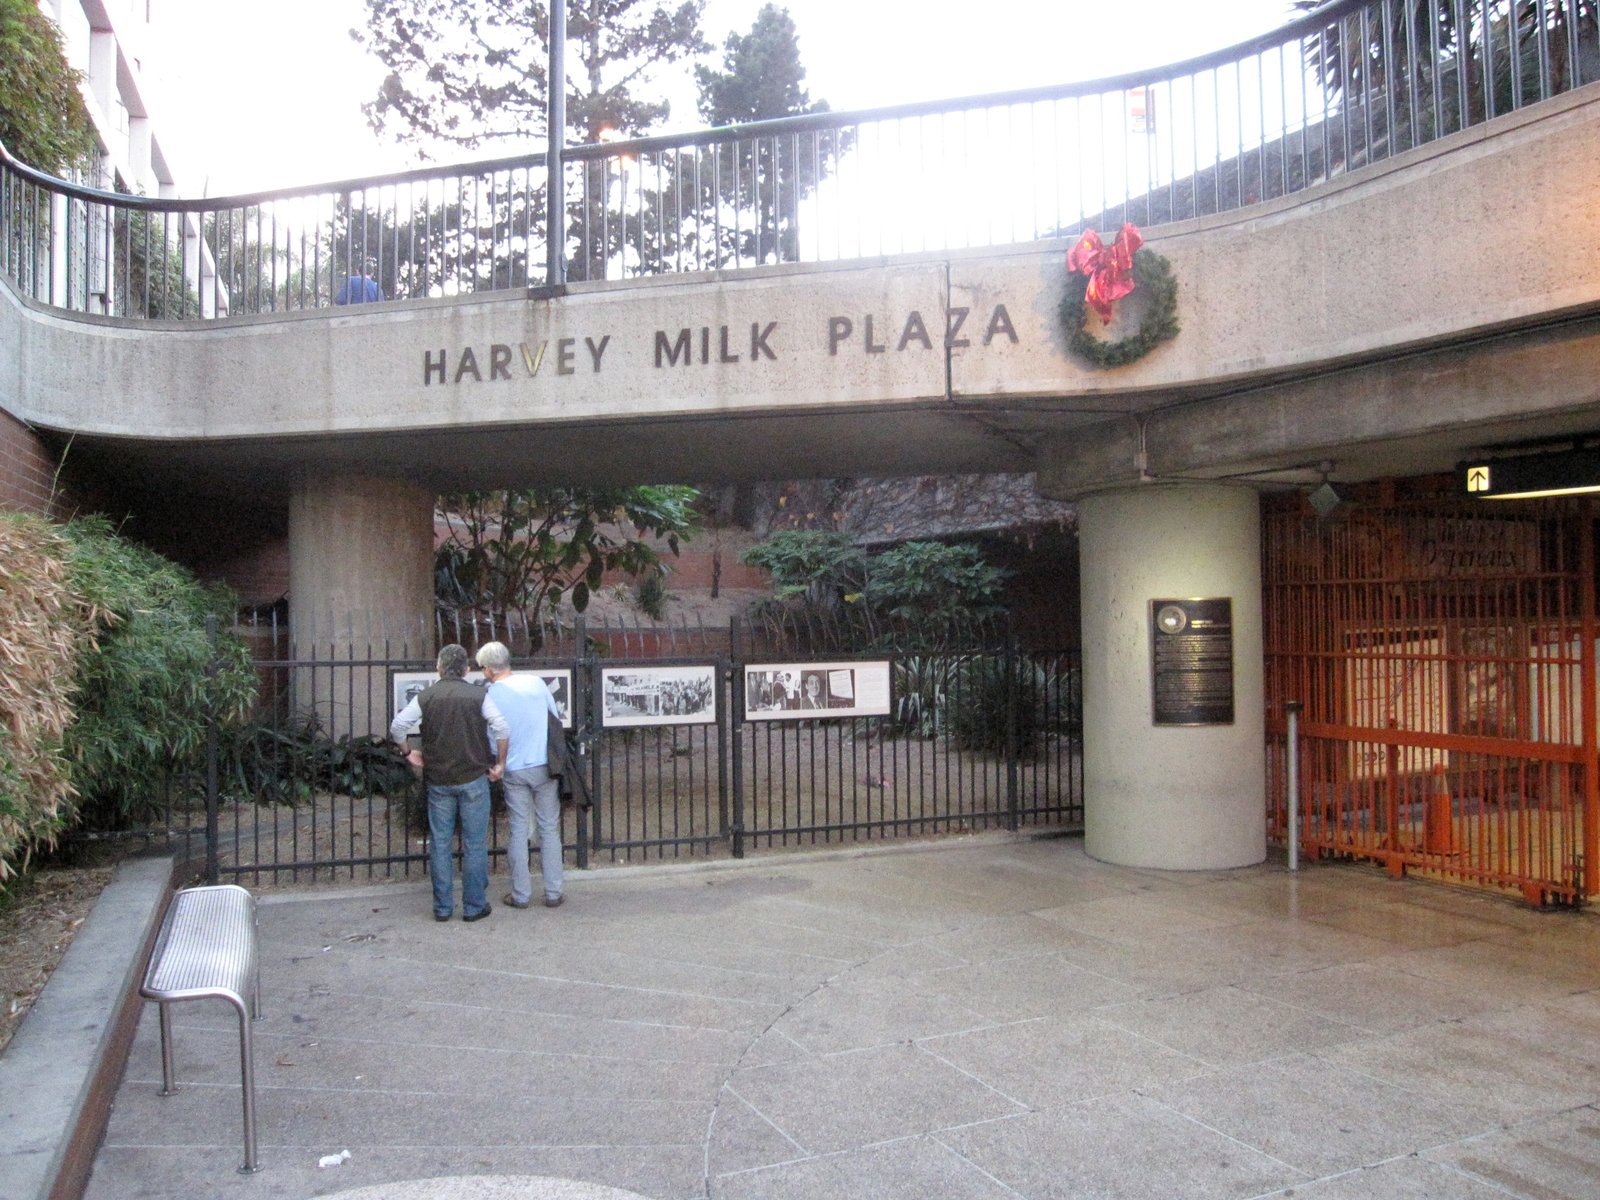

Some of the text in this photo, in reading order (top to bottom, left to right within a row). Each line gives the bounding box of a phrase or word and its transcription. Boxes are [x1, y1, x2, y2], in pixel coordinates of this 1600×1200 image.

[424, 303, 1020, 386] HARVEY MILK PLAZA
